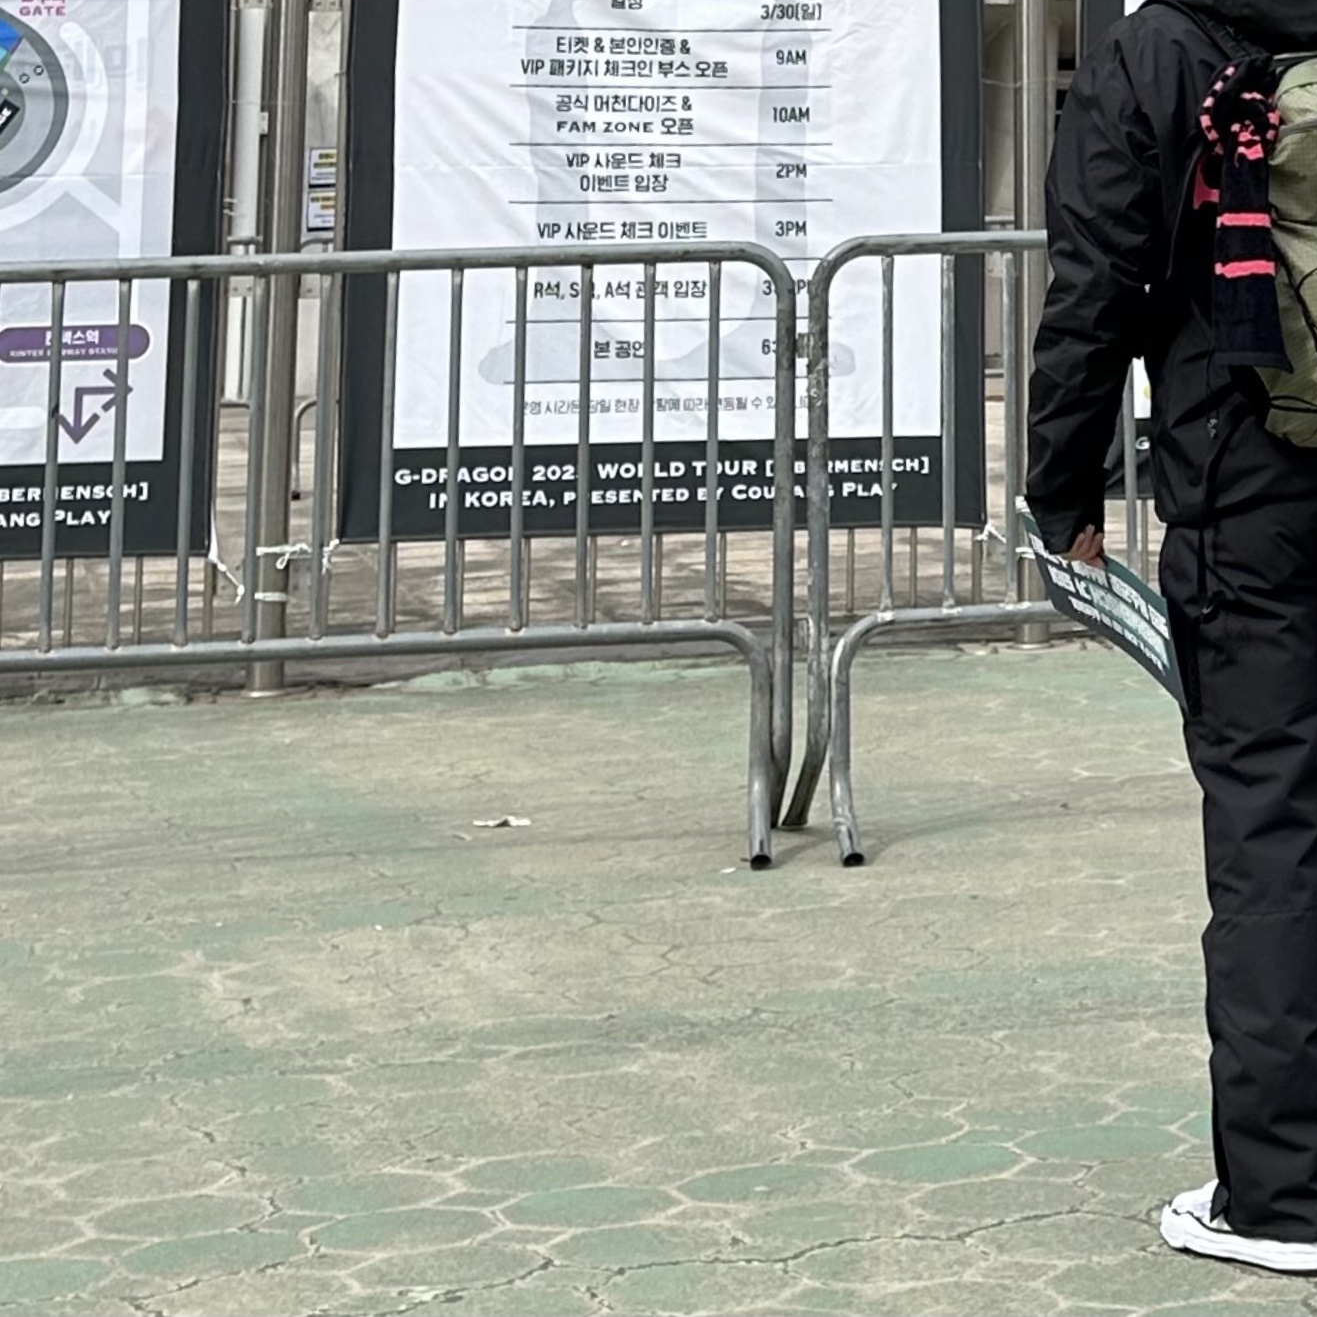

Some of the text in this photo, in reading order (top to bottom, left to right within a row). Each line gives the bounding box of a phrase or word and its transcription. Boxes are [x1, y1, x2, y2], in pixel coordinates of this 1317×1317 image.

[19, 6, 66, 17] GATE
[556, 37, 691, 55] 티켓 & 본인인증 &
[775, 50, 807, 65] 9AM
[521, 59, 729, 78] VIP 패키지 체크인 부스 오픈
[555, 94, 693, 113] 공식 머천다이즈 &
[772, 107, 811, 123] 10AM
[556, 118, 694, 136] FAM ZONE 오픈
[566, 152, 681, 170] VIP 사운드 체크
[775, 163, 808, 179] 2PM
[579, 175, 669, 193] 이벤트 입장
[537, 221, 708, 240] VIP 사운드 체크 이벤트
[774, 221, 808, 237] 3PM
[534, 281, 565, 300] R석,
[569, 281, 601, 300] S,
[605, 281, 631, 299] A석
[674, 280, 707, 298] 입장
[594, 341, 611, 359] 본
[751, 396, 763, 409] 수
[532, 465, 579, 481] 202
[597, 461, 686, 478] WOLD
[563, 487, 690, 505] PESENTED
[842, 482, 898, 498] PLA
